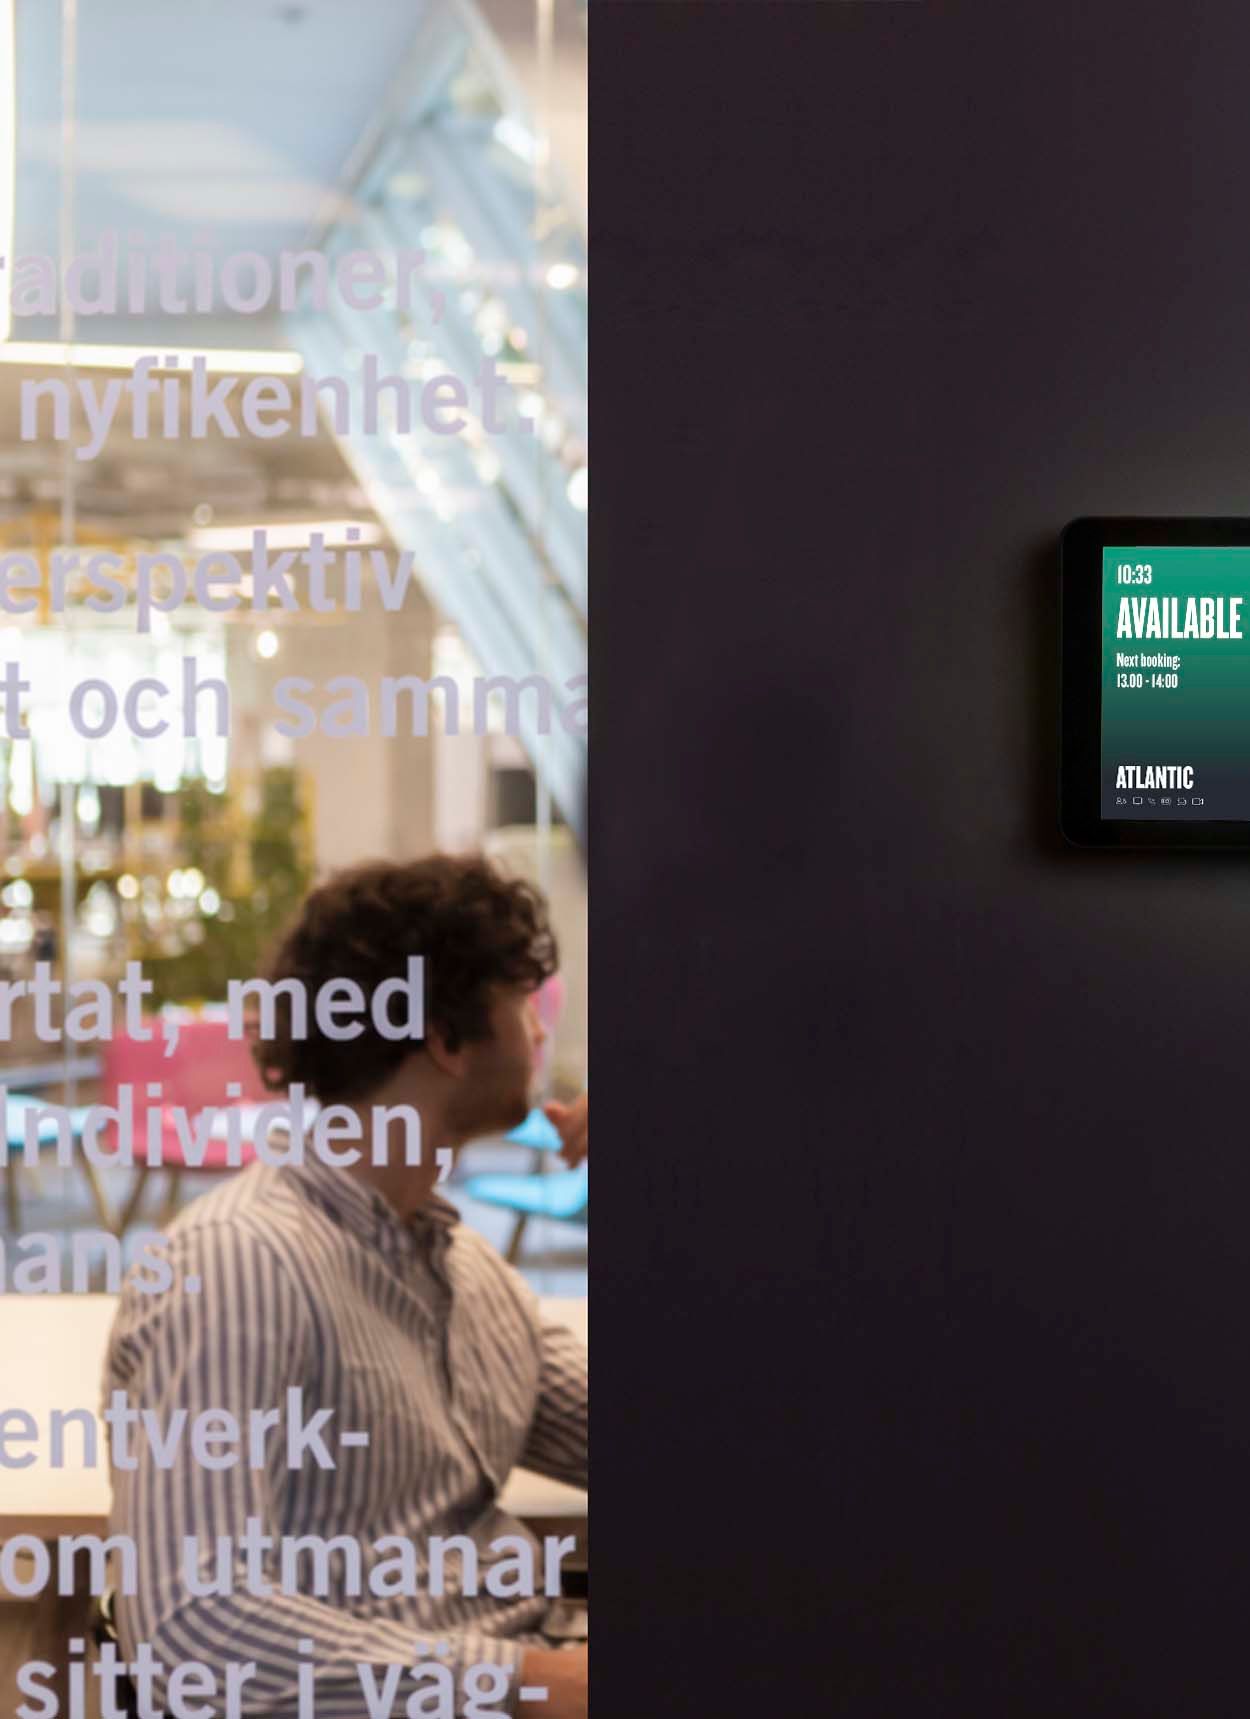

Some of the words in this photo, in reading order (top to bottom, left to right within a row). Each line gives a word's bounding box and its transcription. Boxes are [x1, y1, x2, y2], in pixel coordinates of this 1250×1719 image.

[0, 227, 447, 325] aditioner,
[19, 354, 536, 461] nyfikenhet.
[0, 527, 417, 633] erspektiv
[1117, 564, 1153, 585] 10:33
[1116, 597, 1243, 639] AVAILABLE
[69, 656, 231, 739] och
[1116, 652, 1139, 668] Next
[1140, 652, 1181, 671] booking:
[1117, 673, 1143, 689] 13.00
[1151, 673, 1179, 689] 14:00
[1115, 765, 1194, 790] ATLANTIC
[0, 960, 180, 1057] rtat,
[228, 955, 426, 1041] med
[0, 1231, 202, 1295] ans.
[0, 1386, 370, 1470] entverk-
[0, 1533, 138, 1598] om
[183, 1516, 577, 1598] utmanar
[15, 1637, 258, 1719] sitter
[298, 1637, 314, 1719] i
[356, 1641, 549, 1719] väg-
